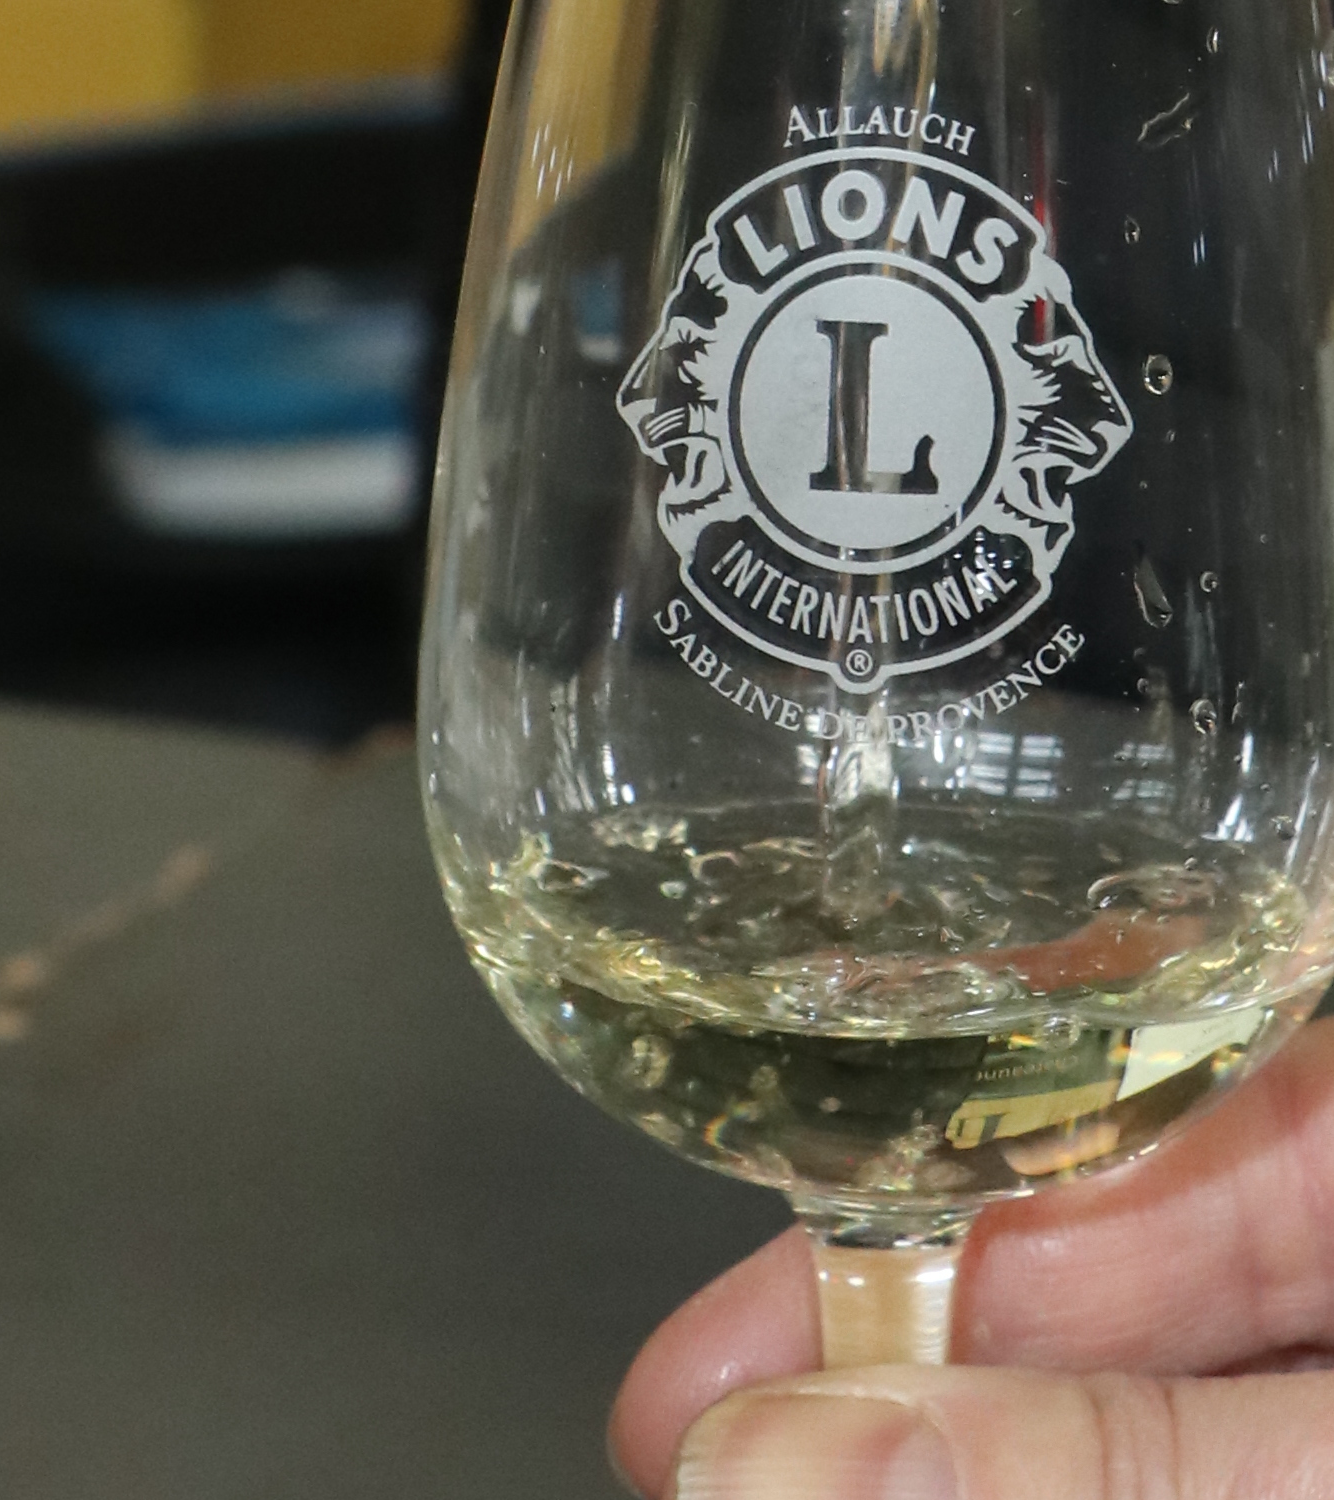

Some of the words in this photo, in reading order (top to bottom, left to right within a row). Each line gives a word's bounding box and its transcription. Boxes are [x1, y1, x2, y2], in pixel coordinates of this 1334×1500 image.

[782, 103, 976, 156] ALLAUCH
[733, 168, 1019, 285] LIONS
[809, 319, 939, 494] L
[711, 539, 1018, 645] INTERNATIONAL
[653, 598, 805, 732] SABLINE
[886, 623, 1086, 744] PROVENCE
